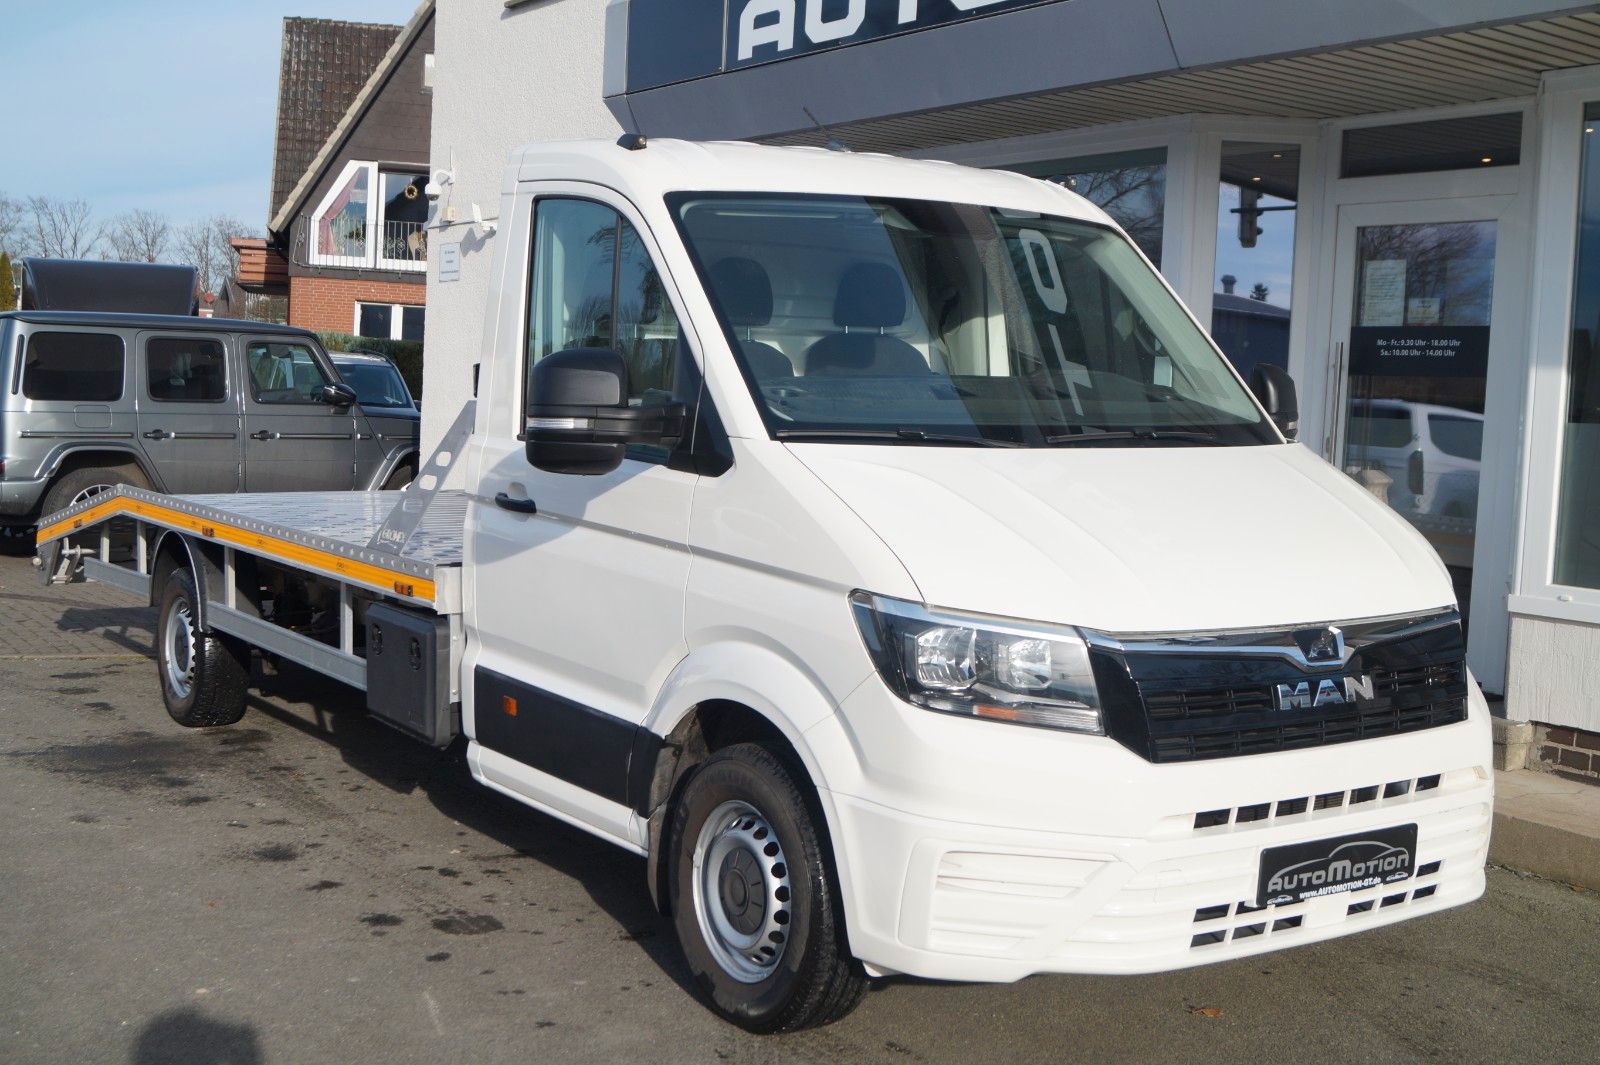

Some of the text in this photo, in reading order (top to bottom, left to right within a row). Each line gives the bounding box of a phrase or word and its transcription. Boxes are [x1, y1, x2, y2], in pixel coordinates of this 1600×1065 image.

[738, 0, 1009, 61] AU
[1443, 349, 1456, 357] Uhr
[1276, 675, 1374, 710] MAN
